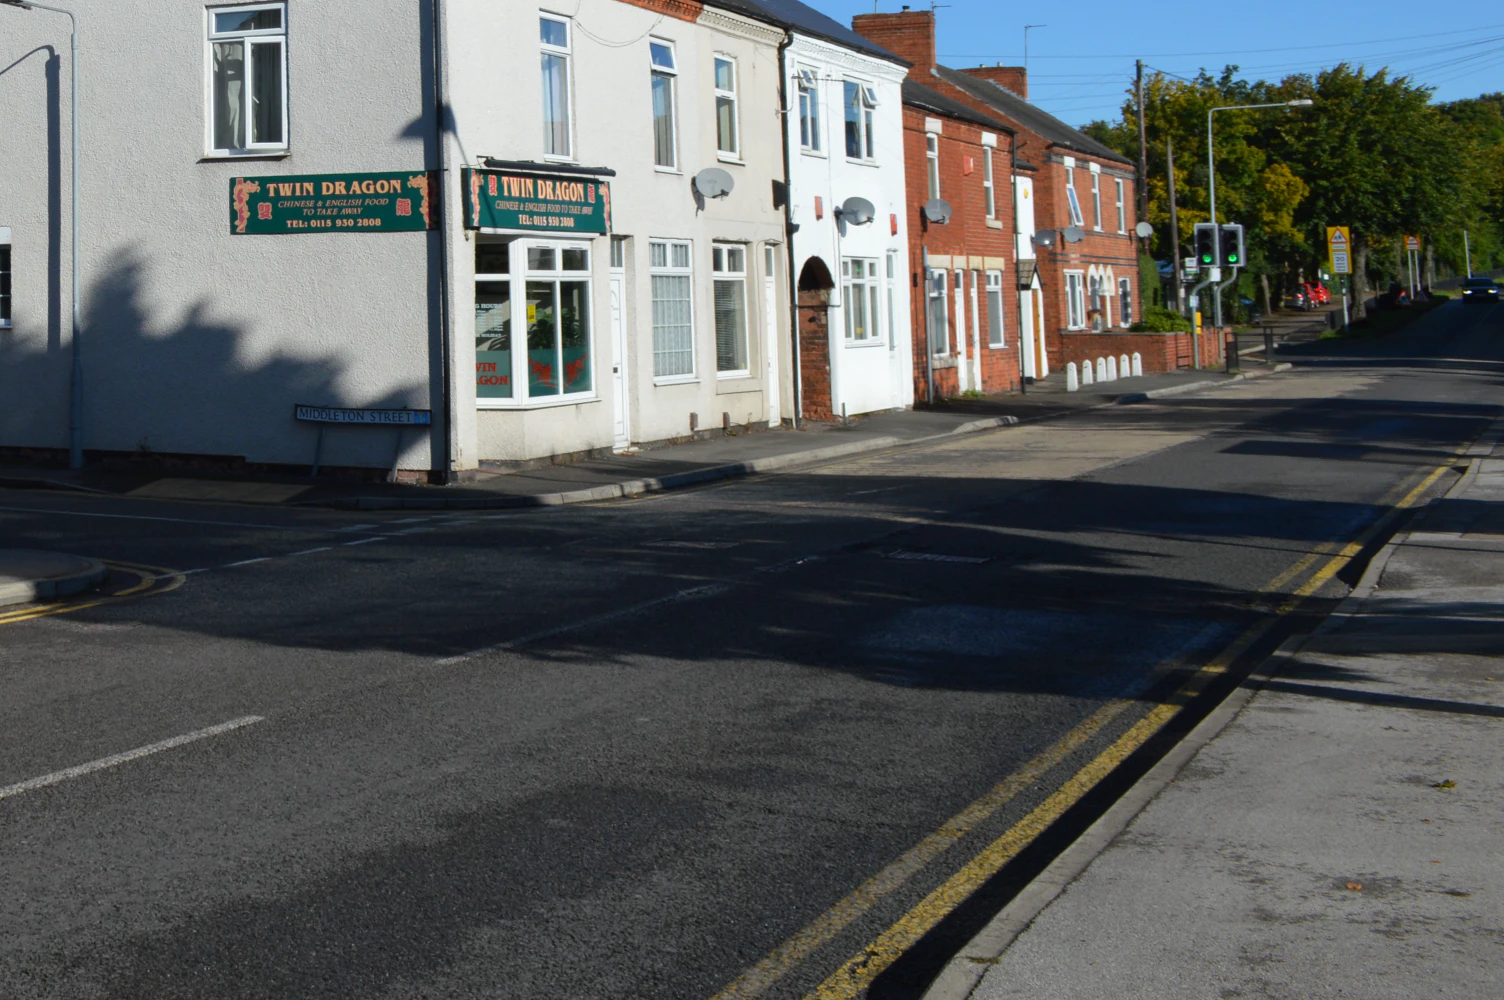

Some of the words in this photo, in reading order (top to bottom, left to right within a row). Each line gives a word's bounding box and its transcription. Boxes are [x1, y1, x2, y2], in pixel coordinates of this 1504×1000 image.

[266, 182, 315, 197] TWIN
[321, 180, 402, 196] DRAGON
[501, 176, 534, 198] TWIN
[537, 179, 585, 202] DRAGON
[277, 200, 315, 208] CHINESE
[325, 199, 363, 207] ENGLISH
[364, 198, 389, 206] FOOD
[495, 200, 519, 210] CHINESE
[525, 202, 547, 212] ENGLISH
[547, 203, 561, 213] FOOD
[561, 204, 569, 213] TO
[569, 205, 581, 214] TAKE
[302, 208, 315, 216] TO
[317, 208, 339, 216] TAKE
[340, 207, 364, 215] AWAY
[286, 220, 308, 228] TEL:
[310, 219, 332, 228] 0115
[356, 218, 382, 227] 2808
[518, 214, 532, 225] TEL:
[476, 375, 509, 385] GON
[298, 408, 365, 422] MIDDLETON
[369, 411, 412, 422] STREET
